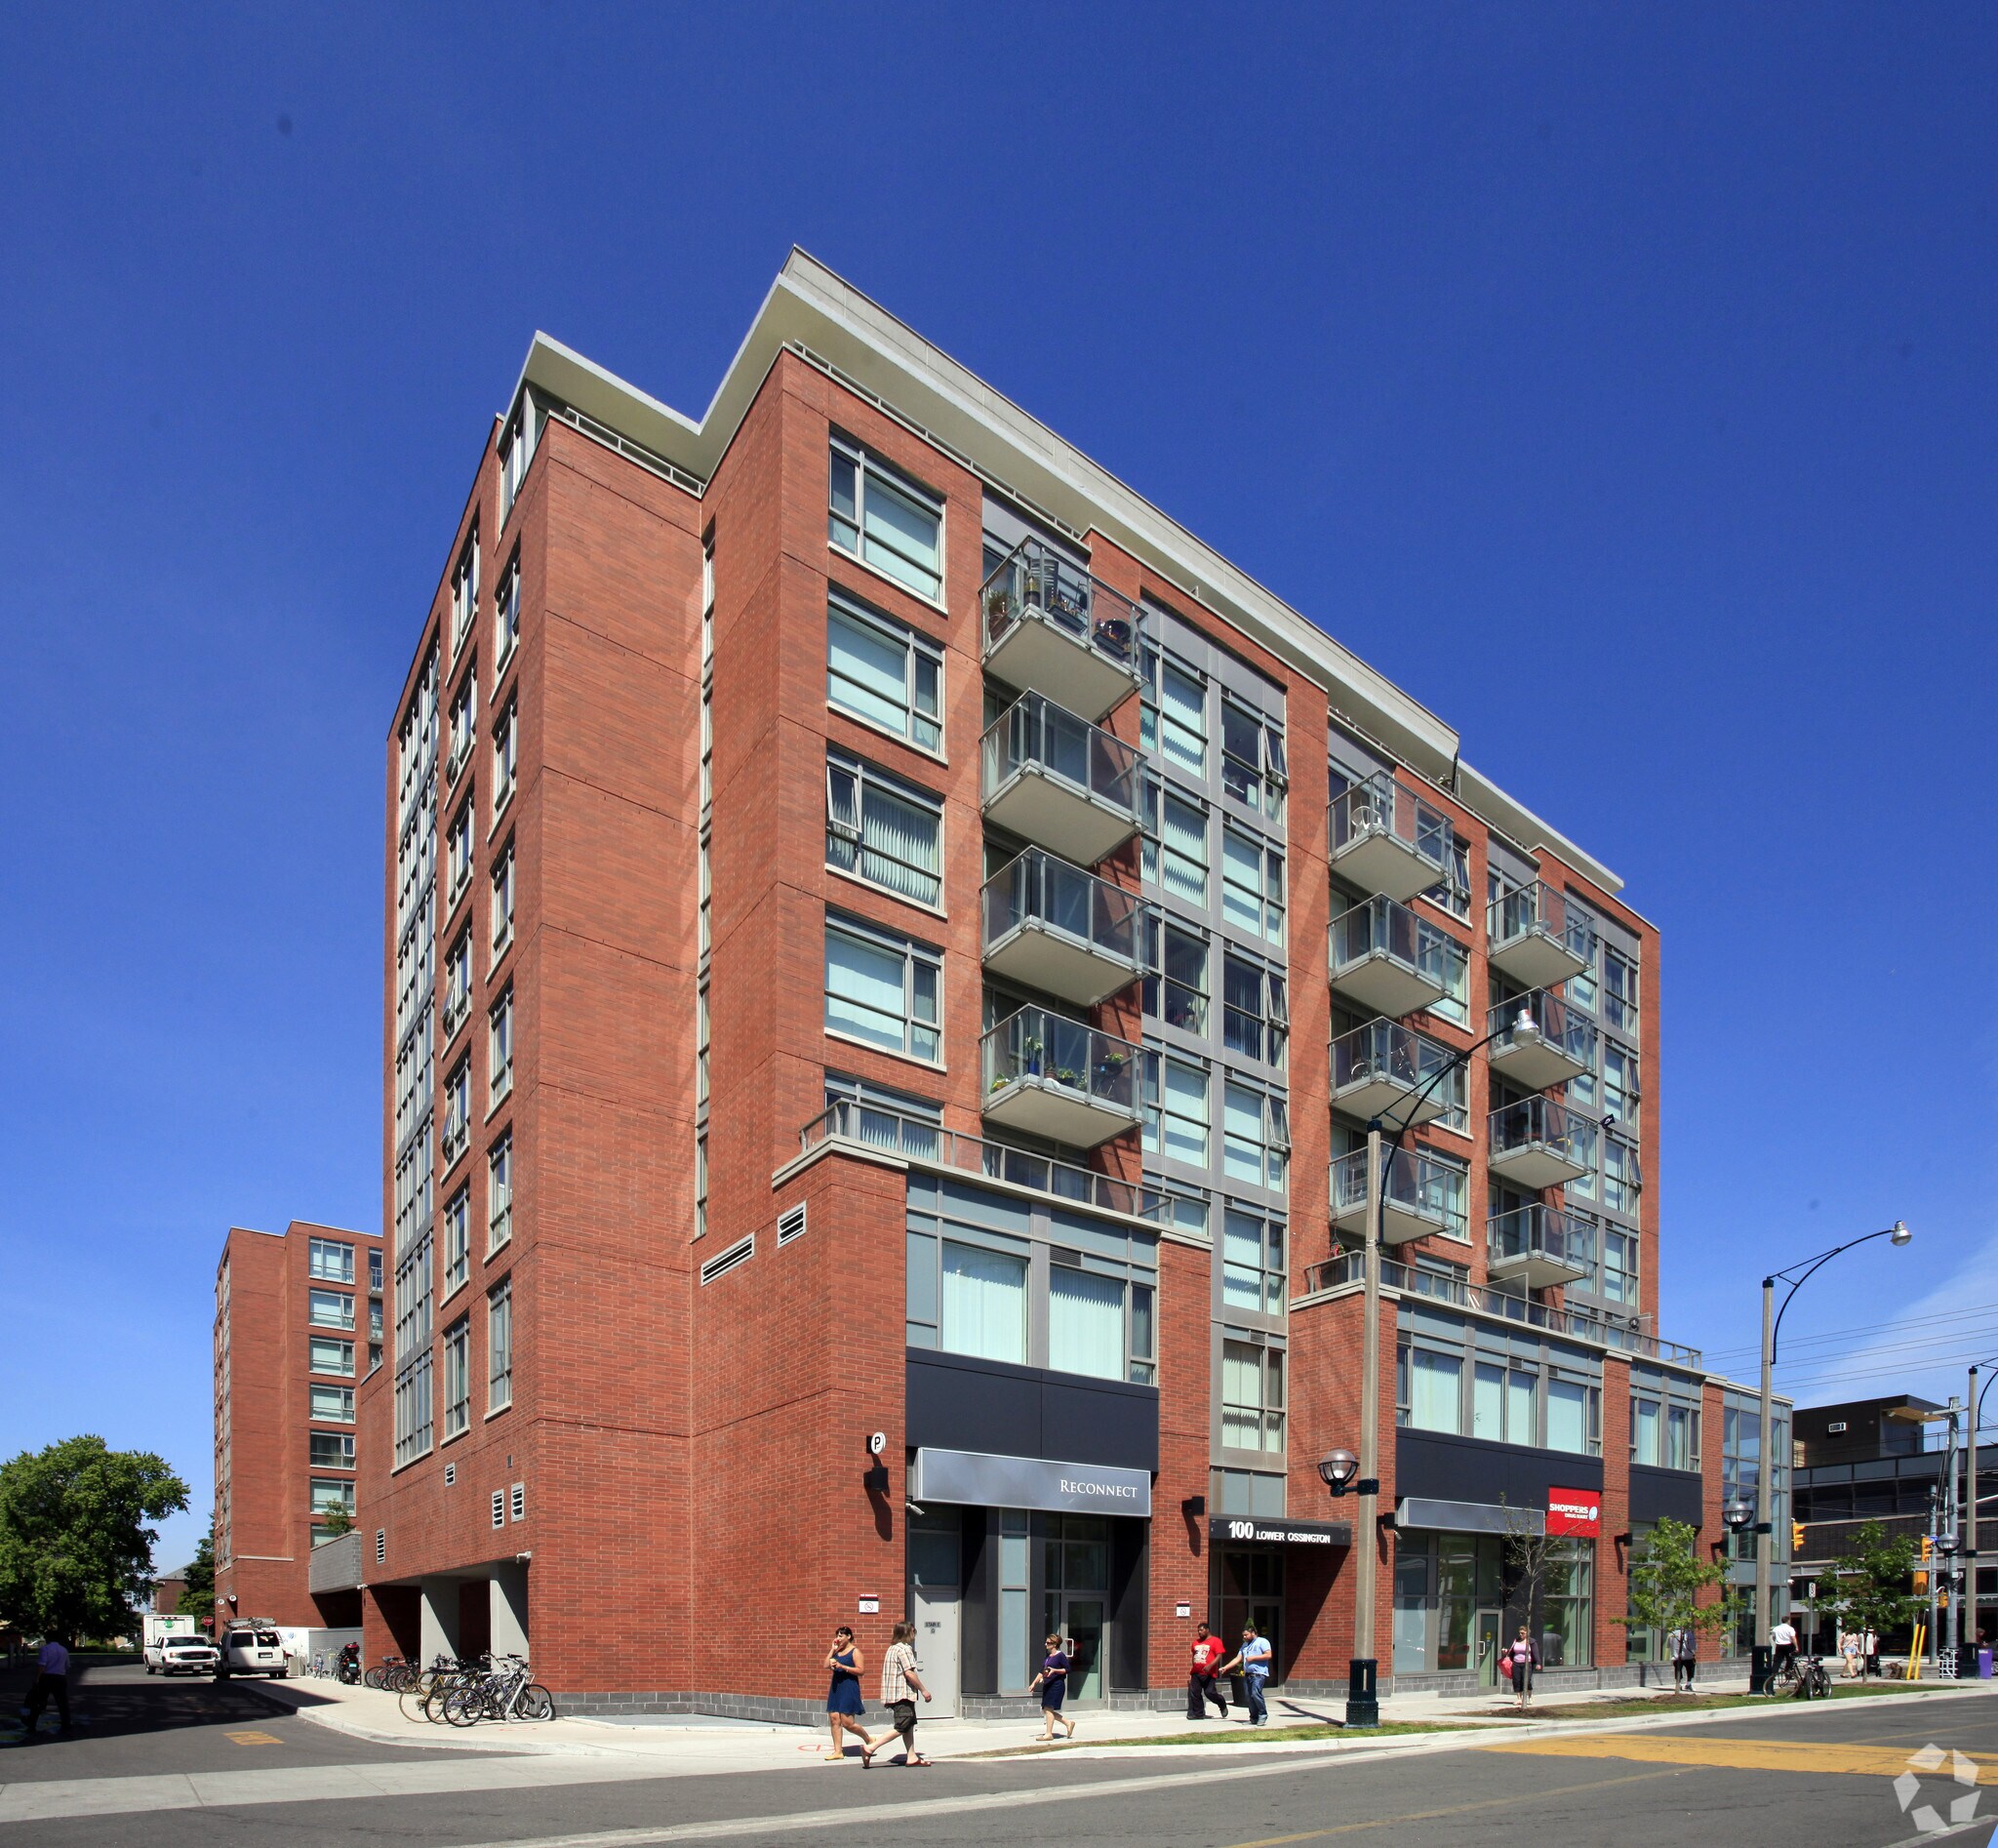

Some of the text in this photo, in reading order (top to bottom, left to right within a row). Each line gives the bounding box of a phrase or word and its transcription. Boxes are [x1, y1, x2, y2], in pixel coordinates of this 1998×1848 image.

[874, 1435, 881, 1450] P
[1059, 1479, 1138, 1498] RECONNECT
[1549, 1504, 1588, 1514] SHOPPERS
[1228, 1521, 1331, 1544] 100 LOWER OSSINGTON
